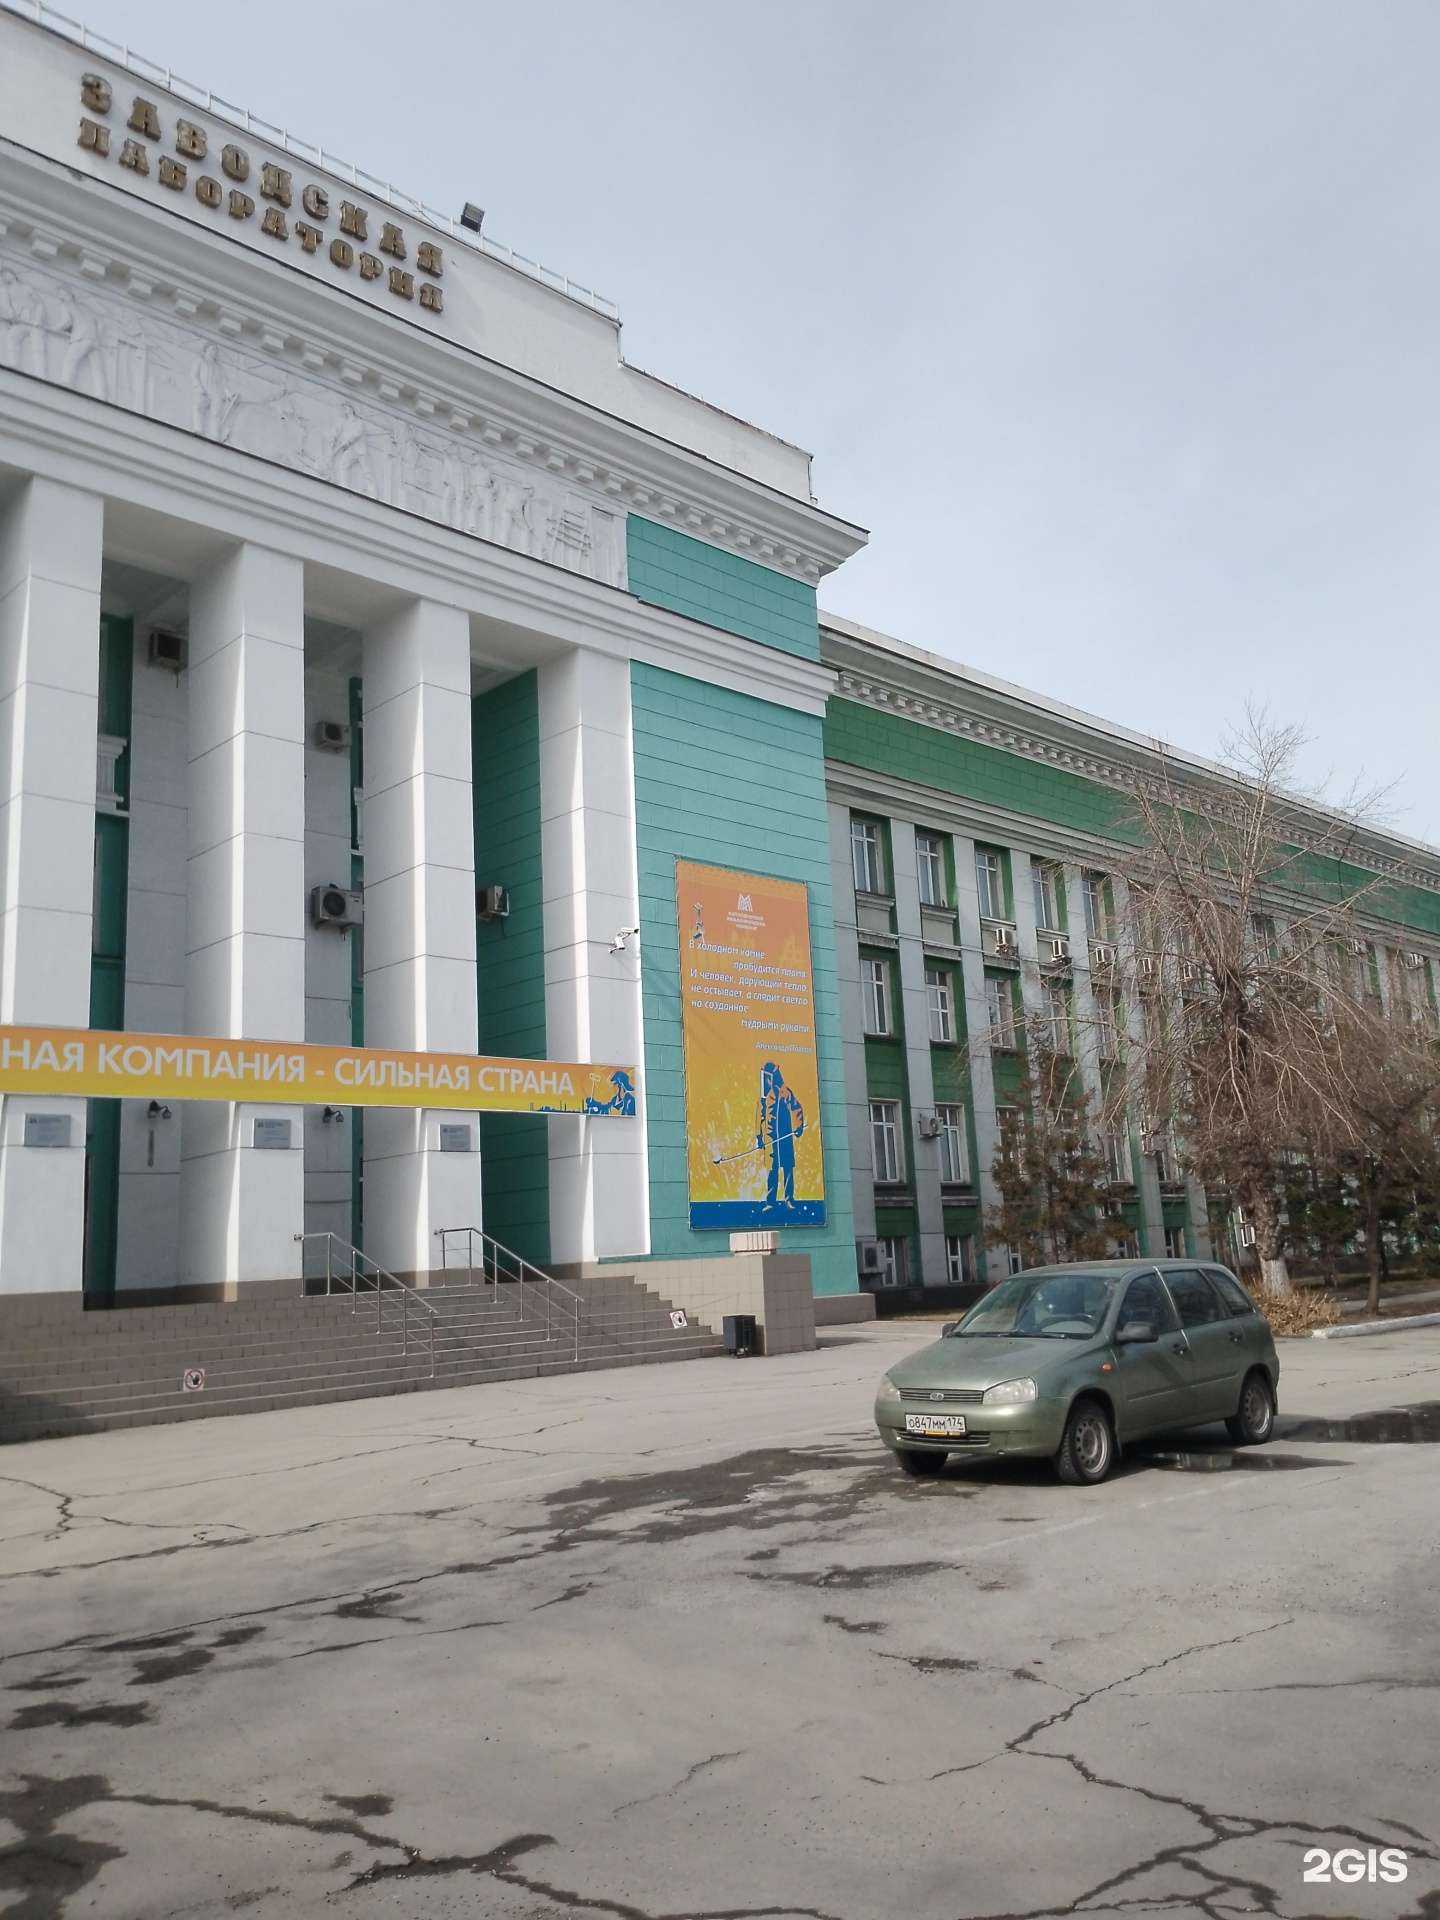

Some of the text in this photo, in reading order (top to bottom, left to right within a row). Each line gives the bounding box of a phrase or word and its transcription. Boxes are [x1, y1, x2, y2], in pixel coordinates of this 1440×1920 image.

[81, 72, 443, 278] ЗАВОДСКАЯ
[78, 117, 443, 313] ЛАБОРАТОРИЯ
[688, 939, 696, 949] В
[690, 968, 697, 978] И
[98, 1042, 305, 1083] КОМПАНИЯ
[334, 1057, 470, 1090] СИЛЬНАЯ
[477, 1066, 575, 1095] СТРАНА
